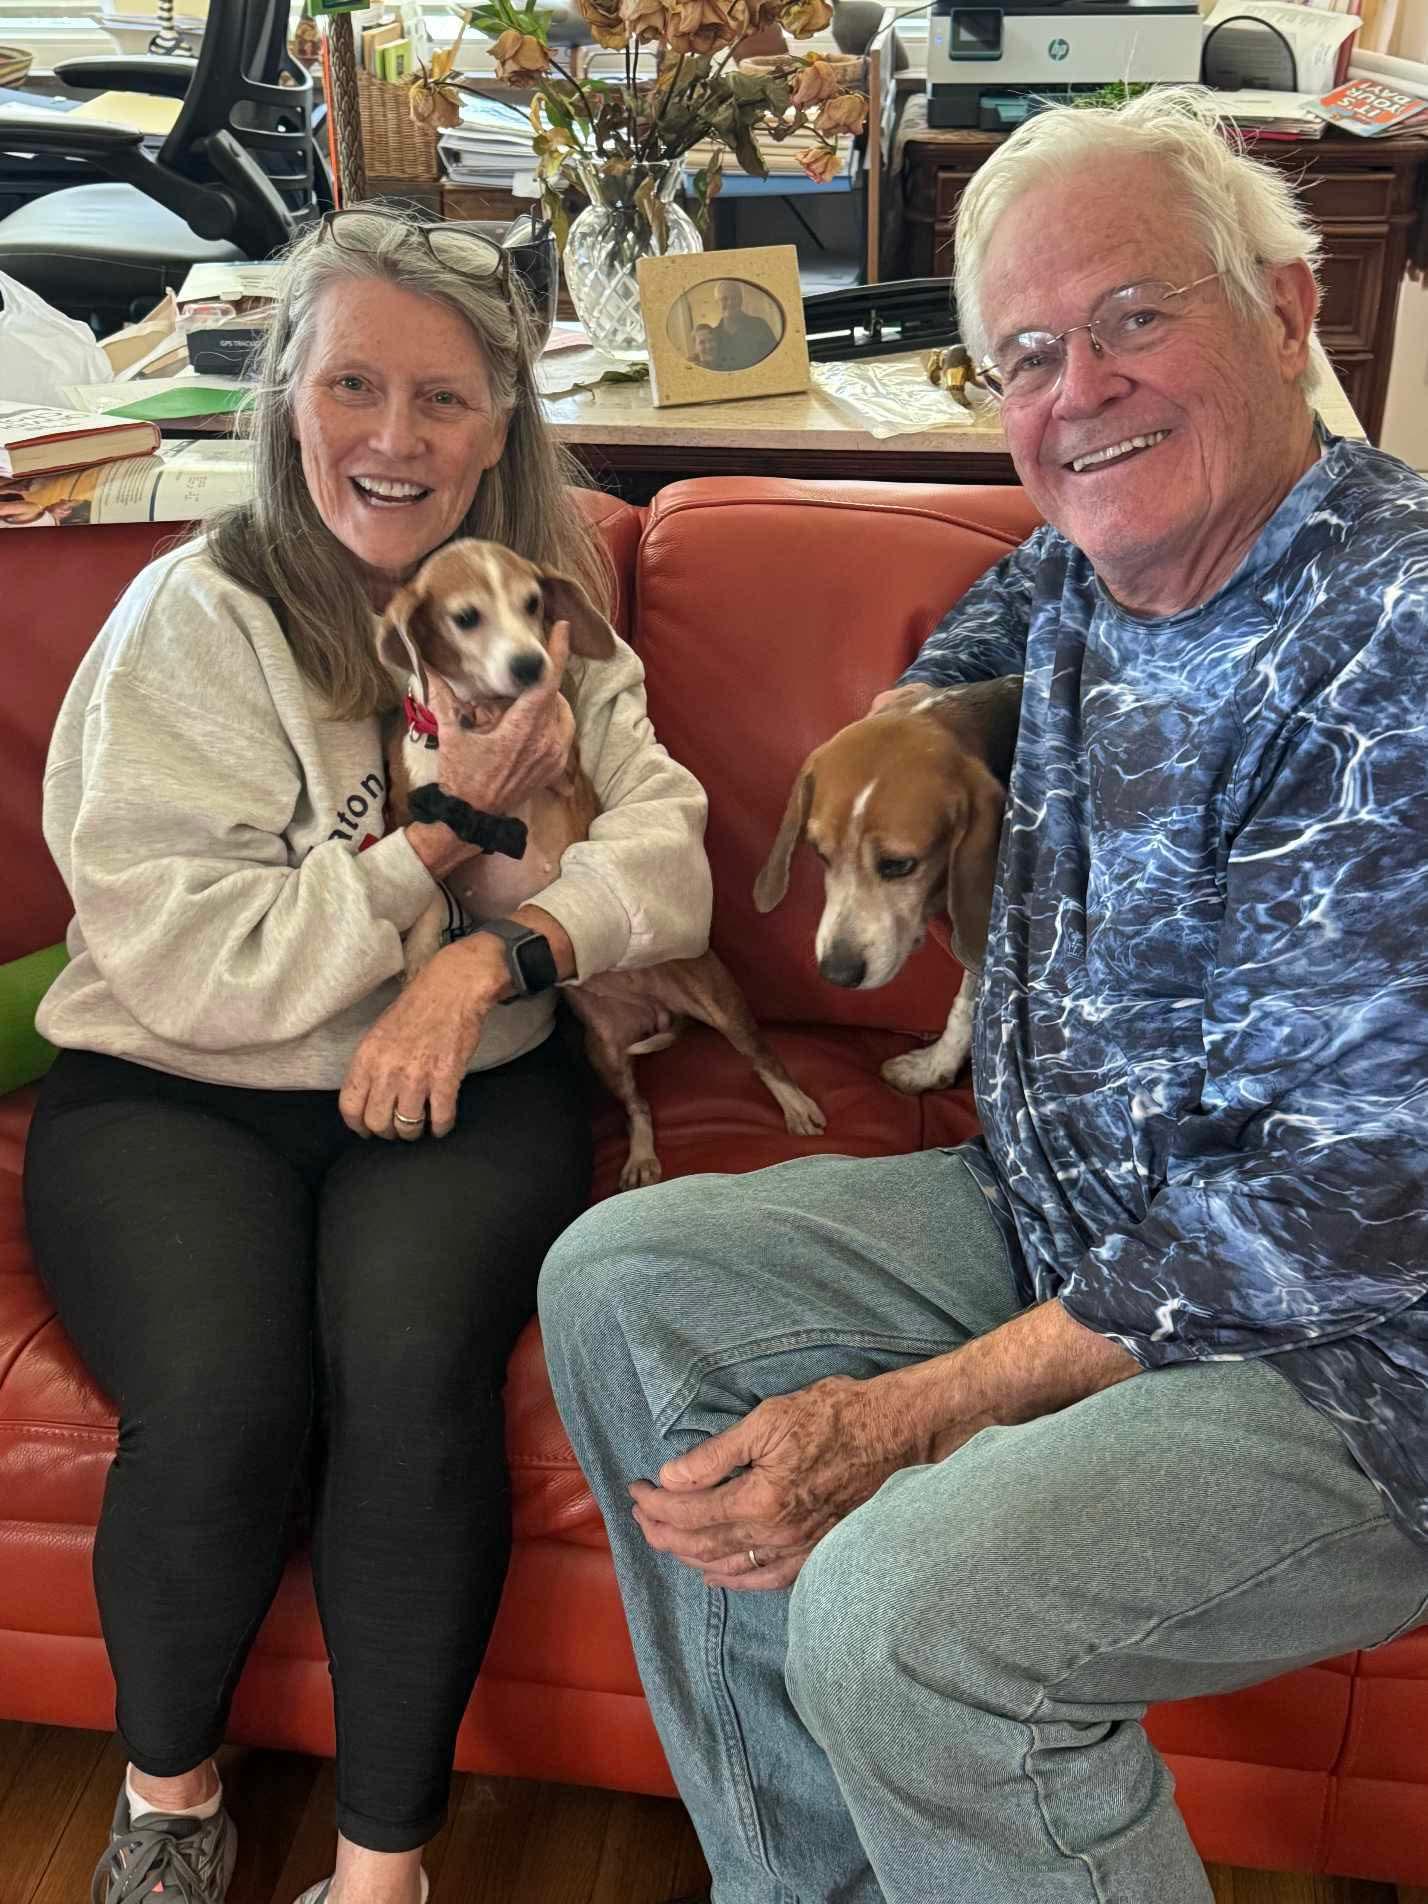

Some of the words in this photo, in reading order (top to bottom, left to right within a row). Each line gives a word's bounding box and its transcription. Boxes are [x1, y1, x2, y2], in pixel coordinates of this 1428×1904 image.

[1048, 38, 1069, 61] hp
[1346, 87, 1404, 113] YOUR
[1358, 81, 1412, 105] DAY!
[1337, 96, 1381, 117] IT'S
